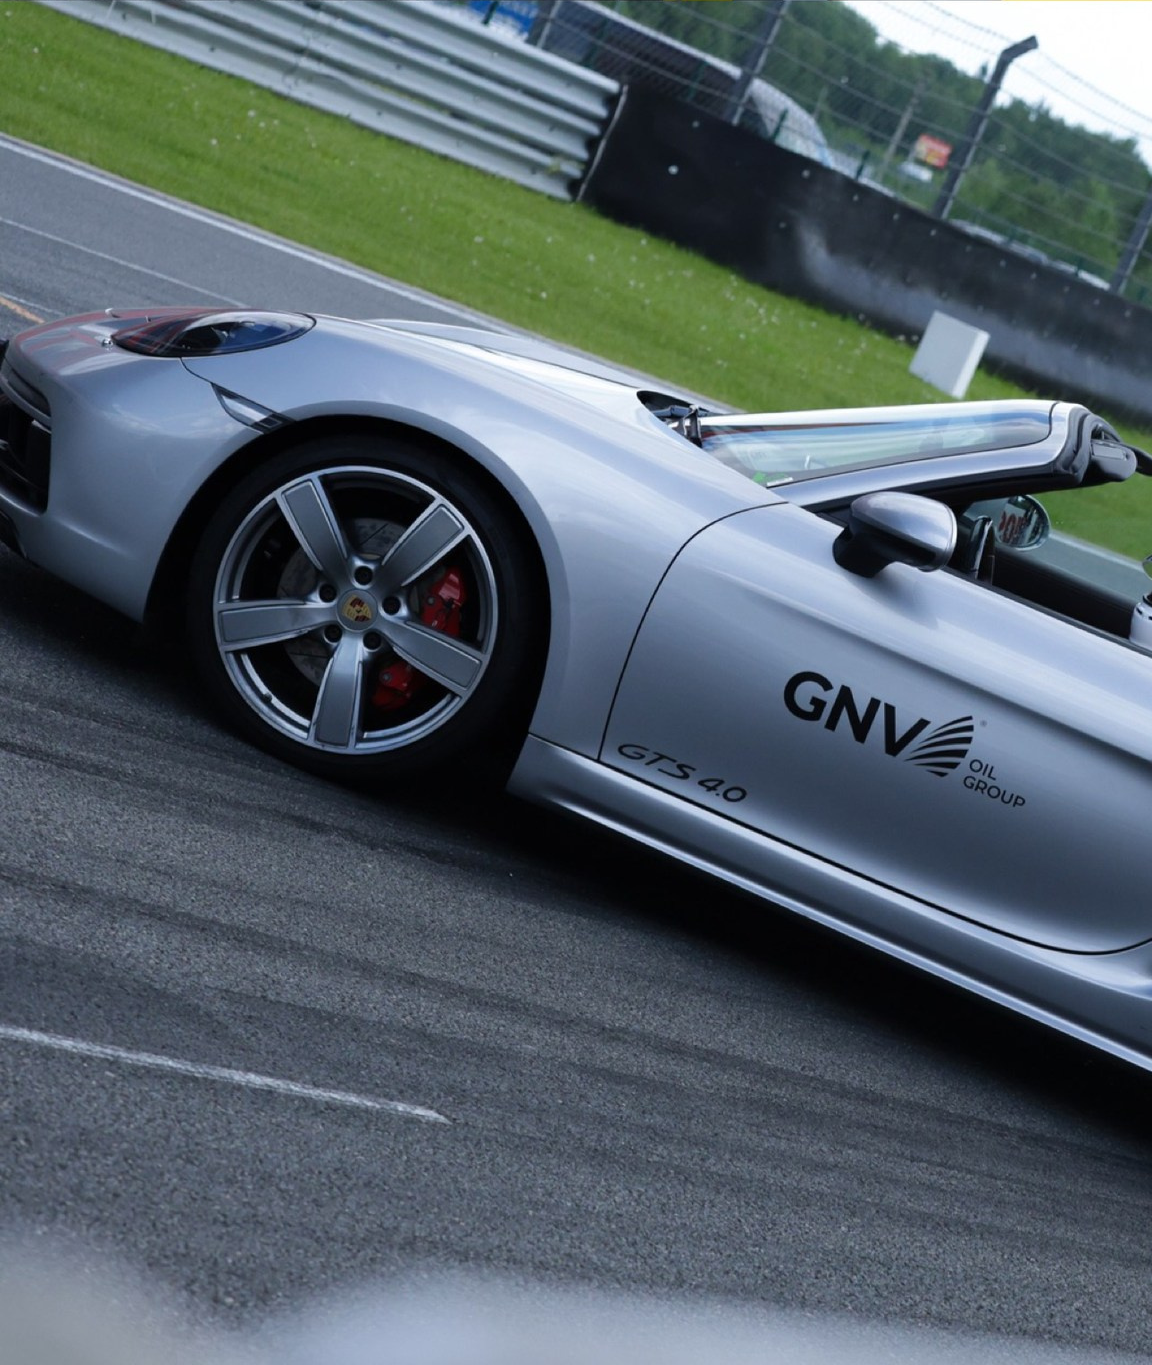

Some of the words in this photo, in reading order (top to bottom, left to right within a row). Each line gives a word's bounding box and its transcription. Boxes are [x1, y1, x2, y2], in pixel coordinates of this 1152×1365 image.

[783, 671, 931, 758] GNV
[617, 743, 696, 781] GTS
[697, 777, 748, 803] 4.0
[963, 775, 1026, 807] GROUP
[969, 759, 996, 781] OIL
